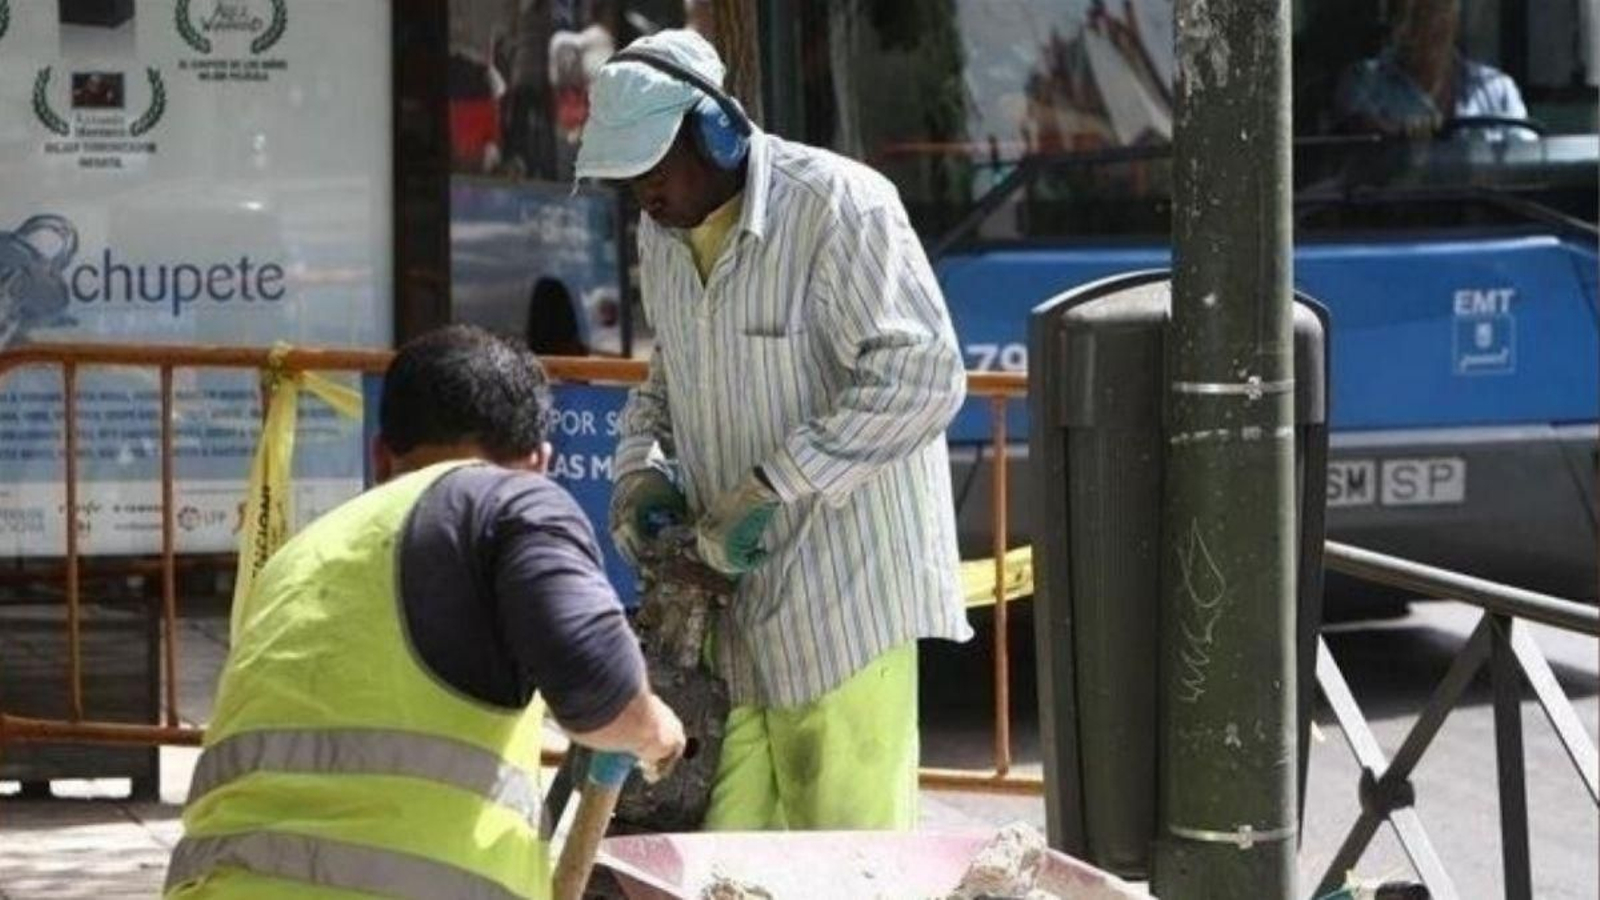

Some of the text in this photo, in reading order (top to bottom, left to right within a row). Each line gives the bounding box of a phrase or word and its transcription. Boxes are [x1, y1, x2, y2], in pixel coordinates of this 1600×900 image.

[71, 249, 286, 316] chupete
[1453, 288, 1515, 315] EMT
[550, 410, 597, 435] POR
[1391, 463, 1455, 501] SP
